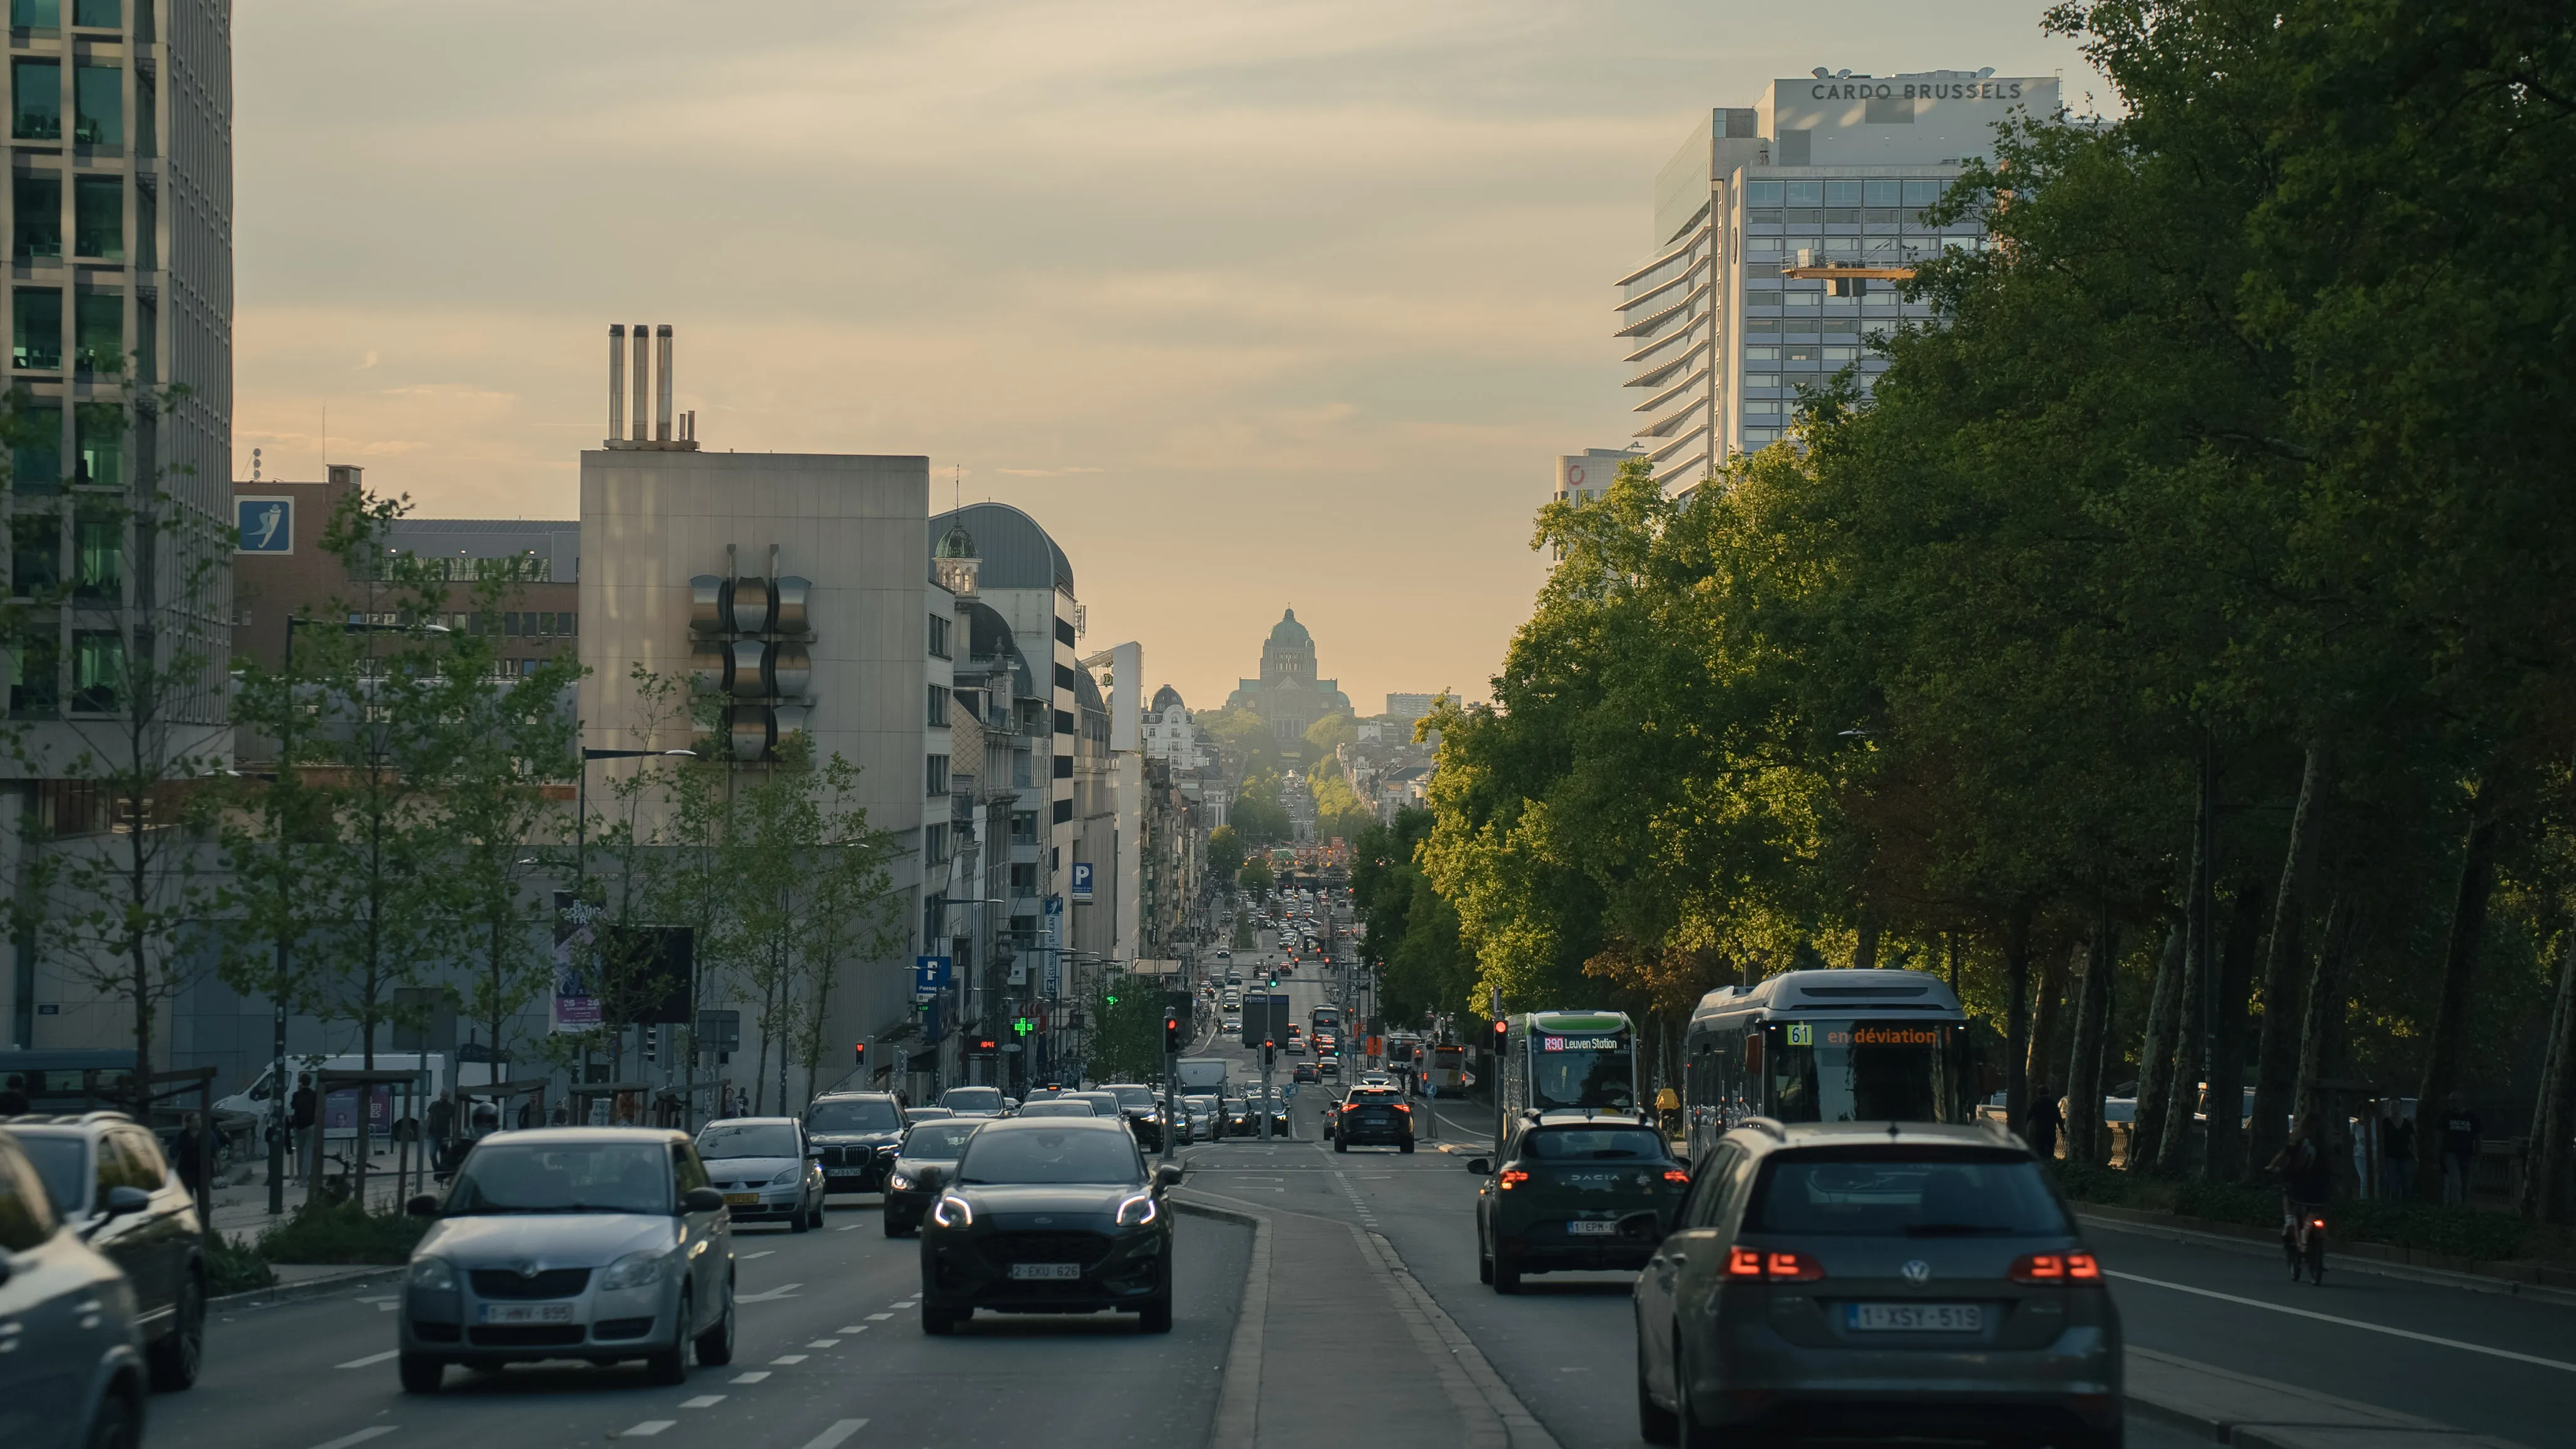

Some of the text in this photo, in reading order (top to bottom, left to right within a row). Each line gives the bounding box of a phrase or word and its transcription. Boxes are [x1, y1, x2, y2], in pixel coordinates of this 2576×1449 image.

[1812, 84, 2021, 100] CARDO BRUSSELS
[1076, 866, 1089, 885] P
[1792, 1027, 1808, 1043] 61
[1828, 1031, 1849, 1043] en
[1854, 1027, 1936, 1043] déviation
[1544, 1038, 1617, 1050] R90 Leuven Station
[1862, 1307, 1978, 1327] 1-XSY-519
